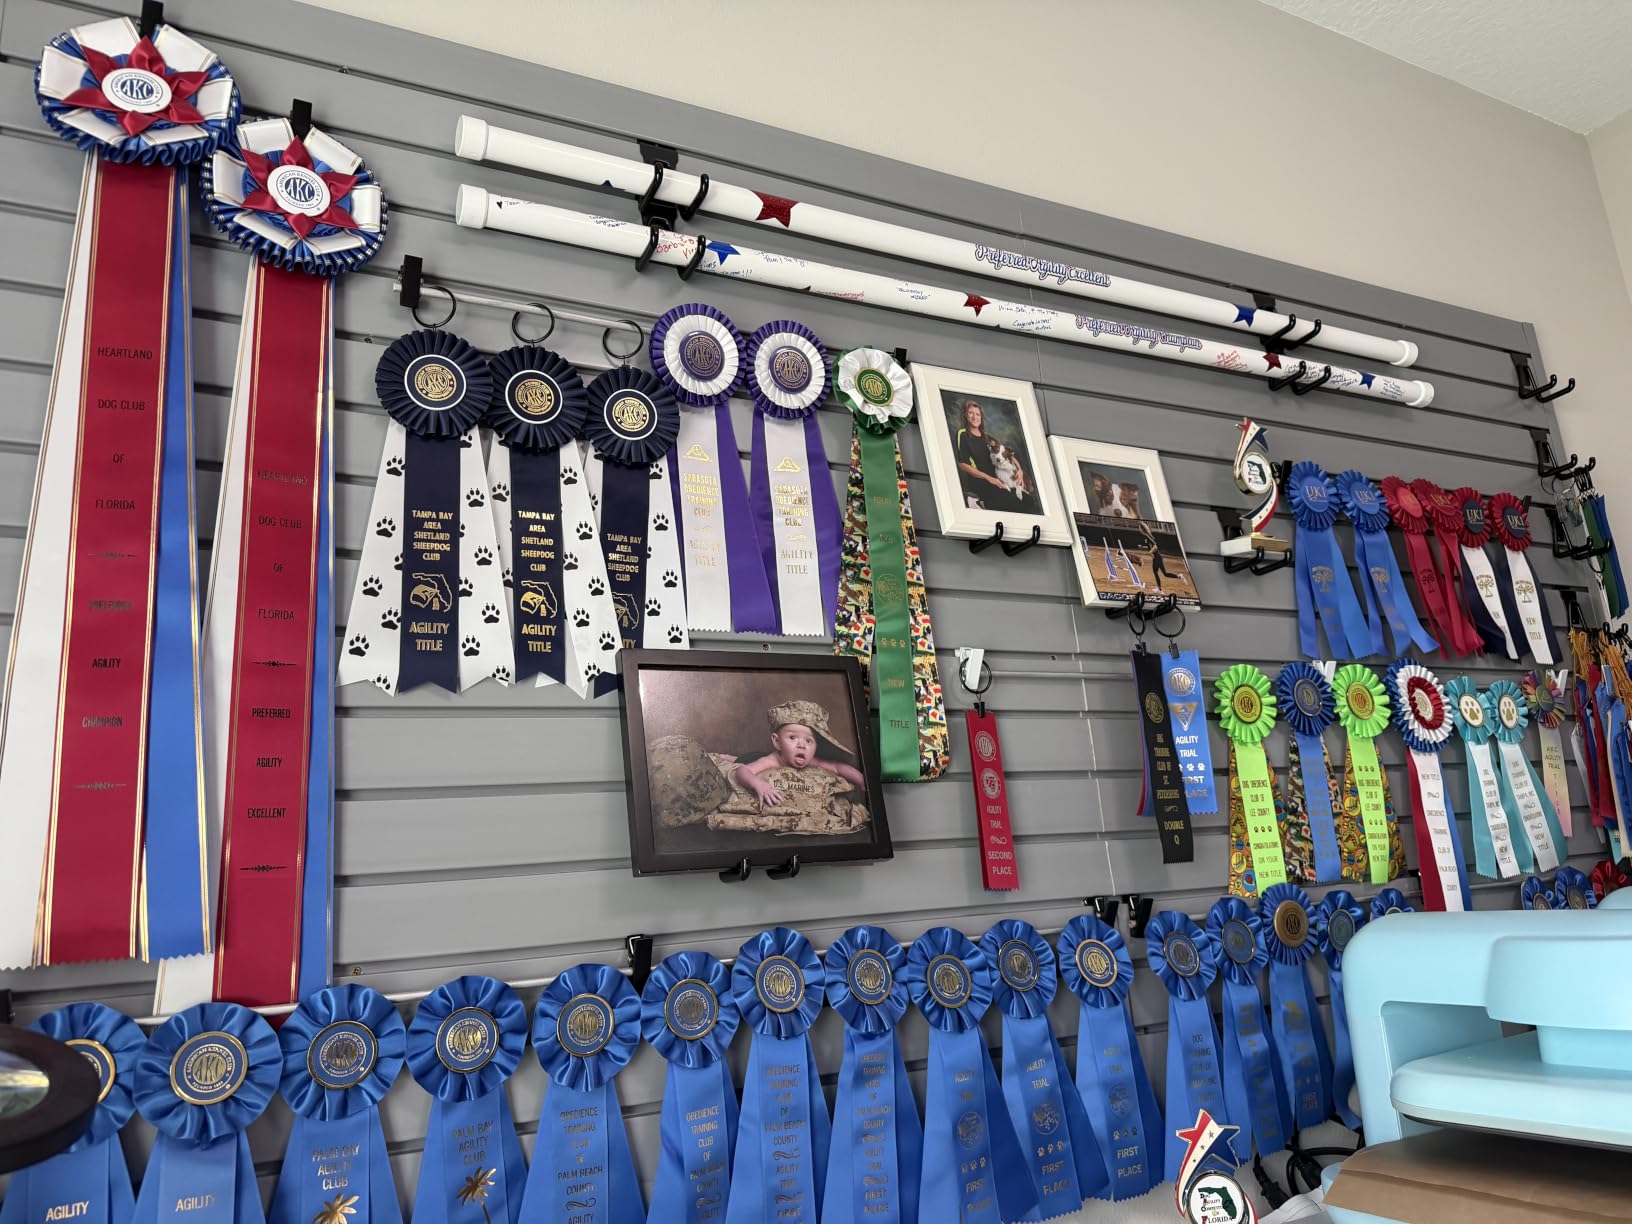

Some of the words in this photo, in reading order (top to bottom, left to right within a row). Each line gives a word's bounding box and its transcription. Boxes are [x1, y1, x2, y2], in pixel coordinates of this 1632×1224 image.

[120, 78, 154, 100] AKC
[285, 177, 315, 203] AKC
[975, 244, 1030, 270] Preferred
[1029, 259, 1070, 285] Agility
[1069, 266, 1111, 288] Excellent
[1075, 315, 1125, 337] Preferred
[1124, 325, 1160, 349] Agility
[1159, 331, 1203, 353] Champion
[98, 347, 153, 360] HEARTLAND
[783, 359, 800, 380] AKC
[426, 374, 446, 391] AKC
[526, 388, 545, 405] AKC
[98, 399, 118, 409] DOG
[121, 400, 145, 411] CLUB
[623, 406, 640, 421] AKC
[113, 453, 125, 463] OF
[684, 483, 719, 497] OBEDIENCE
[774, 485, 809, 496] SARASOTA
[1305, 485, 1327, 498] UKI
[775, 495, 809, 506] OBEDIENCE
[1355, 490, 1375, 503] UKI
[95, 499, 136, 511] FLORIDA
[412, 509, 437, 518] TAMPA
[439, 510, 454, 520] BAY
[517, 510, 541, 519] TAMPA
[542, 511, 555, 520] BAY
[1466, 508, 1483, 521] UKI
[1506, 514, 1524, 527] UKI
[258, 515, 276, 526] DOG
[280, 518, 302, 529] CLUB
[423, 521, 442, 529] AREA
[785, 517, 802, 527] CLUB
[529, 524, 546, 533] AREA
[413, 531, 450, 541] SHETLAND
[521, 536, 554, 545] SHETLAND
[607, 533, 628, 543] TAMPA
[629, 535, 642, 544] BAY
[412, 541, 451, 551] SHEEPDOG
[616, 544, 632, 553] AREA
[422, 552, 441, 561] CLUB
[520, 549, 555, 559] SHEEPDOG
[608, 552, 639, 563] SHETLAND
[780, 549, 813, 560] AGILITY
[273, 562, 284, 573] OF
[530, 563, 546, 572] CLUB
[694, 556, 716, 567] TITLE
[607, 563, 640, 573] SHEEPDOG
[786, 564, 808, 575] TITLE
[615, 573, 631, 582] CLUB
[258, 608, 295, 620] FLORIDA
[409, 621, 450, 634] AGILITY
[521, 623, 557, 636] AGILITY
[1529, 631, 1542, 640] TITLE
[415, 639, 443, 651] TITLE
[527, 640, 552, 652] TITLE
[92, 657, 121, 669] AGILITY
[1171, 674, 1191, 691] AKC
[252, 707, 291, 719] PREFERRED
[82, 716, 123, 728] CHAMPION
[889, 719, 910, 729] TITLE
[1175, 735, 1199, 744] AGILITY
[1179, 749, 1199, 757] TRIAL
[256, 757, 282, 768] AGILITY
[1547, 762, 1561, 770] TRIAL
[247, 807, 286, 819] EXCELLENT
[1164, 820, 1185, 830] DOUBLE
[1174, 834, 1181, 845] Q
[1534, 833, 1545, 841] NEW
[1538, 843, 1549, 851] TITLE
[988, 851, 1012, 860] SECOND
[992, 866, 1012, 875] PLACE
[1025, 1058, 1046, 1072] AGILITY
[1032, 1078, 1050, 1089] TRIAL
[560, 1106, 599, 1121] OBEDIENCE
[686, 1105, 720, 1121] OBEDIENCE
[476, 1119, 494, 1133] BAY
[691, 1120, 719, 1134] TRAINING
[863, 1119, 886, 1129] COUNTY
[457, 1135, 489, 1153] AGILITY
[698, 1135, 714, 1148] CLUB
[773, 1134, 798, 1146] COUNTY
[463, 1150, 486, 1166] CLUB
[703, 1151, 711, 1162] OF
[1117, 1146, 1139, 1160] FIRST
[557, 1169, 578, 1181] PALM
[579, 1164, 604, 1177] BEACH
[1041, 1160, 1065, 1176] FIRST
[1117, 1163, 1143, 1178] PLACE
[322, 1176, 349, 1191] CLUB
[566, 1182, 595, 1195] COUNTY
[1043, 1179, 1070, 1196] PLACE
[175, 1194, 216, 1212] AGILITY
[45, 1200, 90, 1222] AGILITY
[568, 1213, 593, 1224] AGILITY
